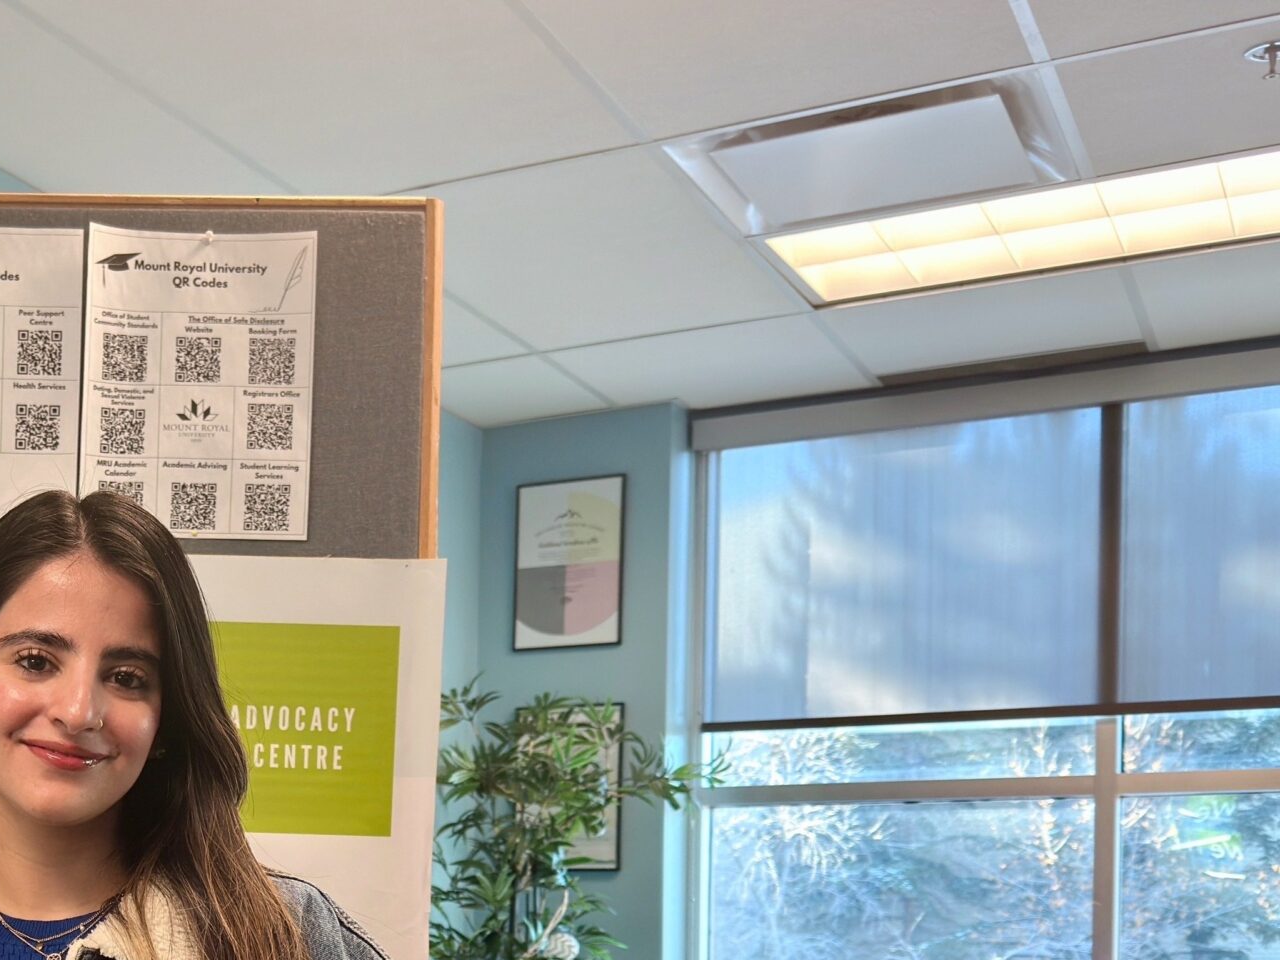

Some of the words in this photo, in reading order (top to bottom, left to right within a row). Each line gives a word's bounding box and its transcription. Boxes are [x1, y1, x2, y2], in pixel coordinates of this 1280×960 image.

[134, 260, 171, 272] Mount
[174, 262, 206, 274] Royal
[209, 263, 267, 276] University
[173, 277, 189, 288] QR
[193, 277, 228, 288] Codes
[36, 310, 64, 318] Support
[163, 424, 199, 432] MOUNT
[202, 424, 230, 433] ROYAL
[230, 704, 355, 732] ADVOCACY
[254, 743, 343, 770] CENTRE
